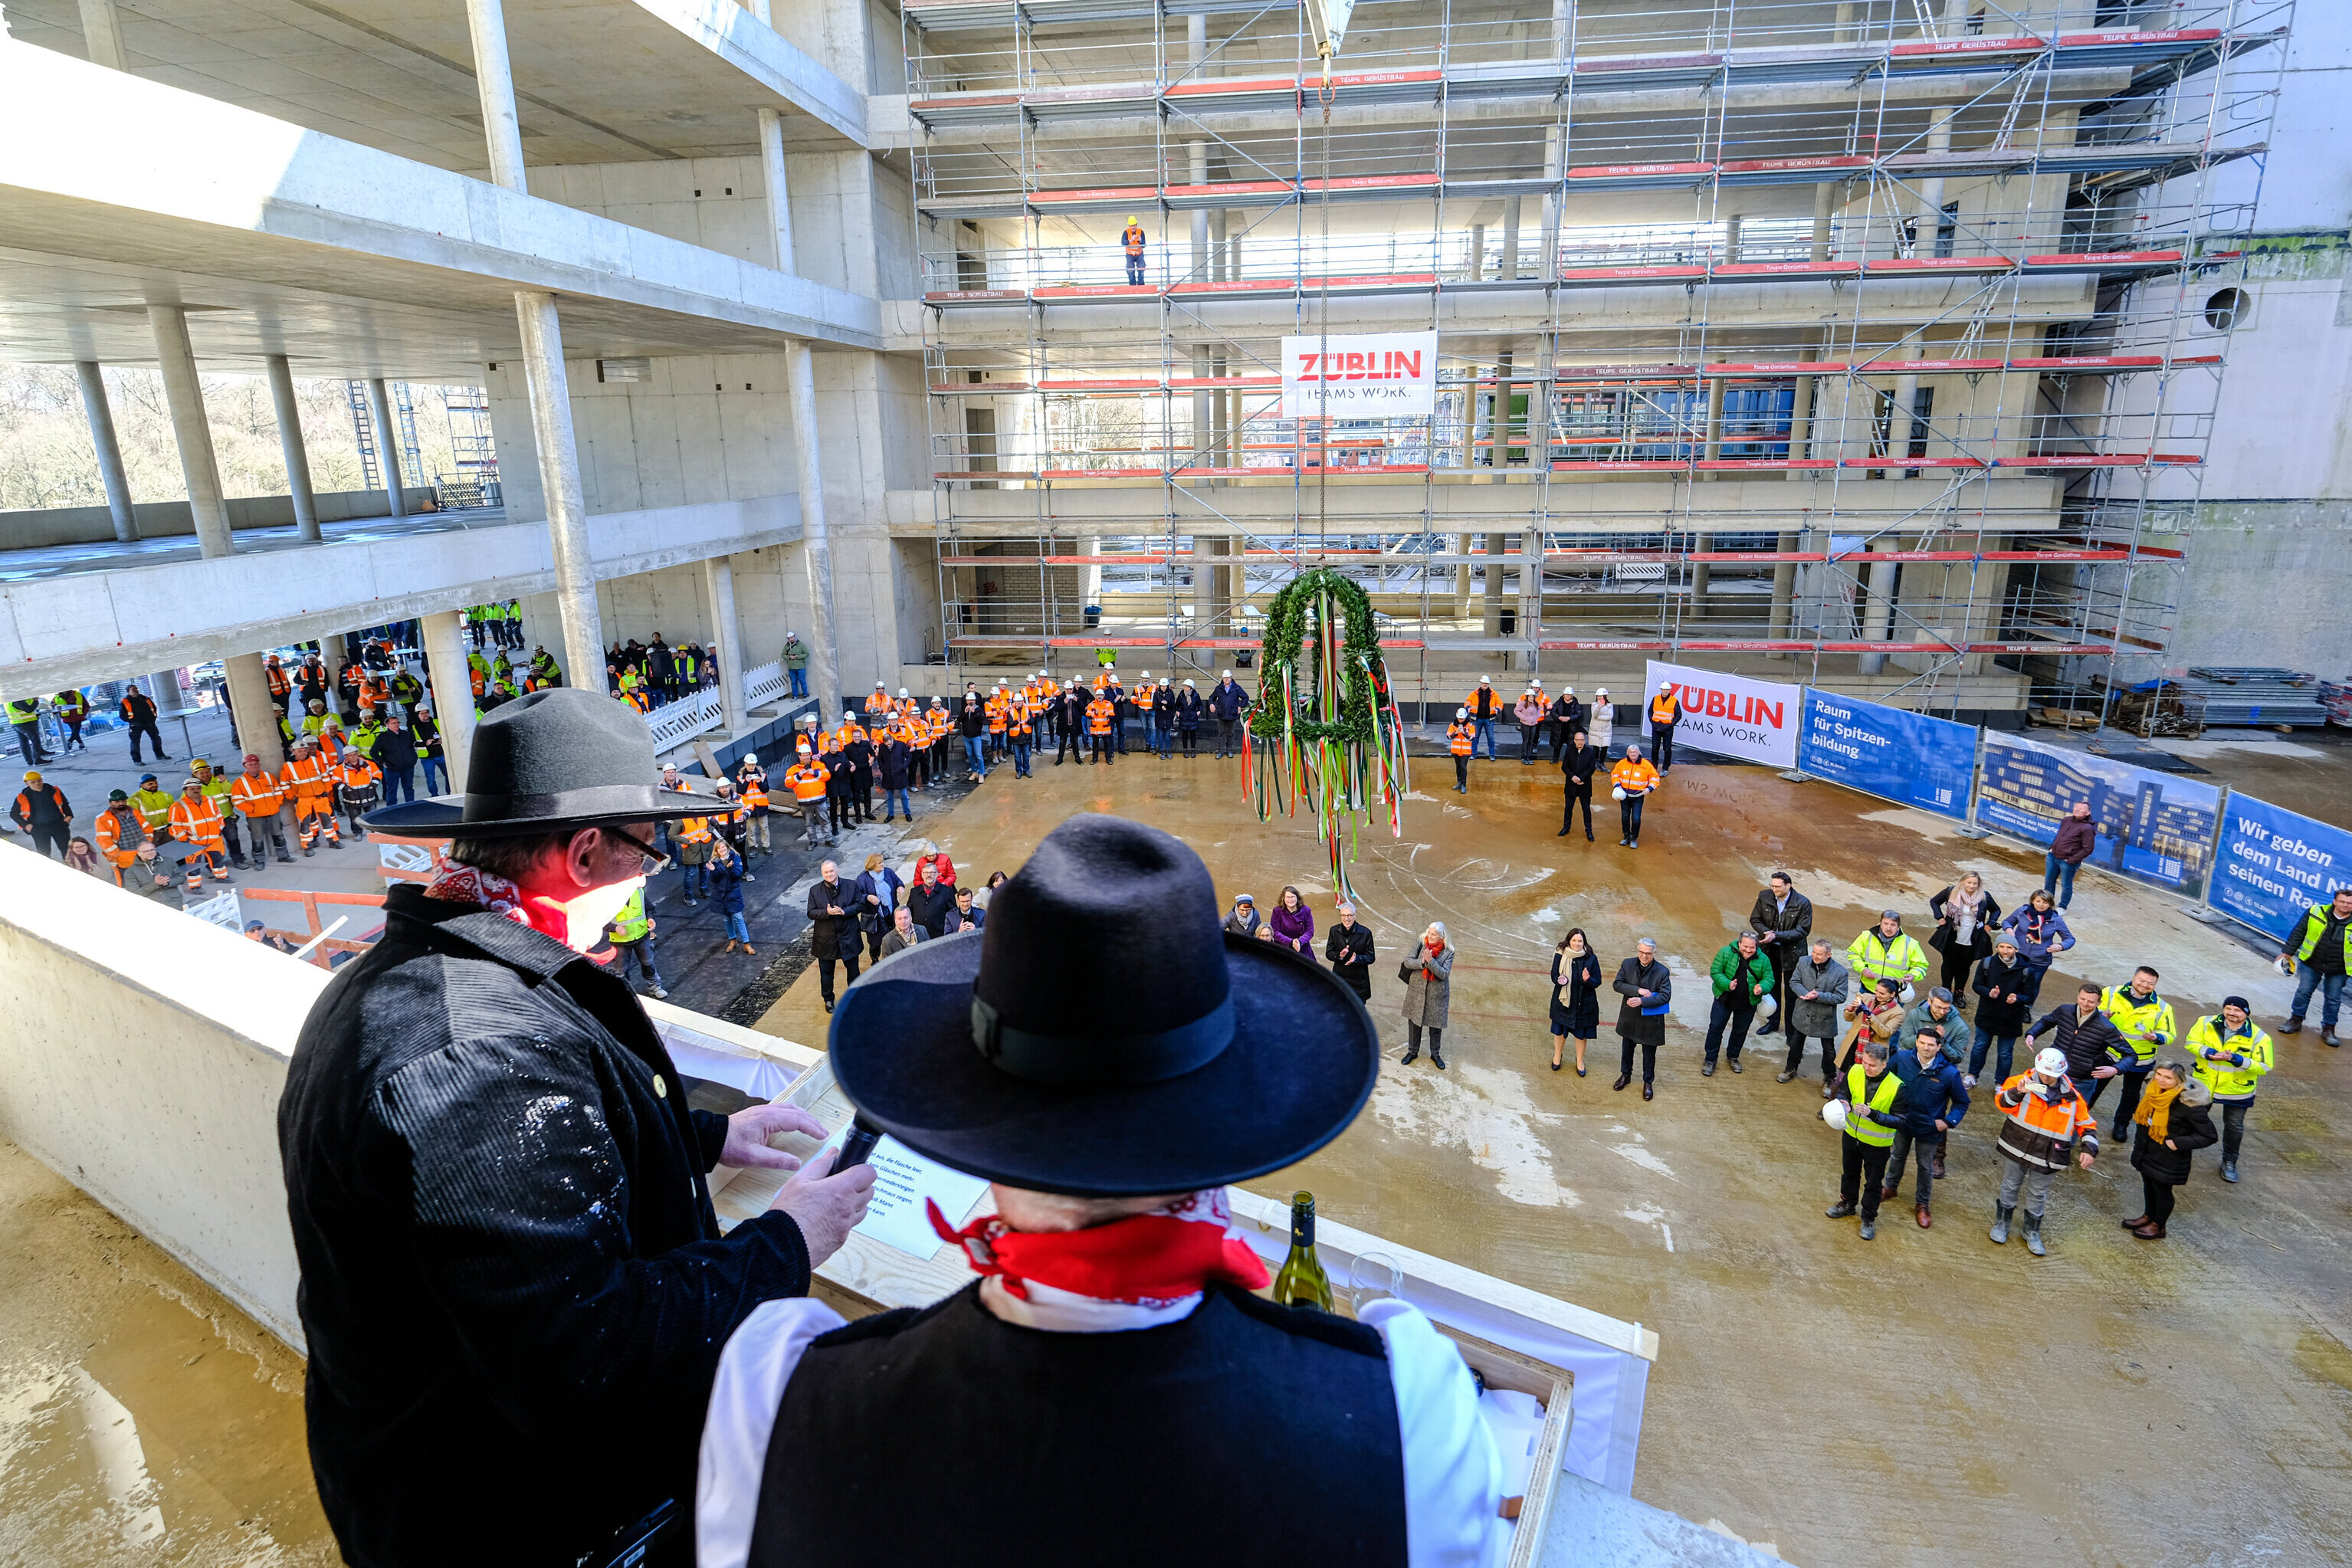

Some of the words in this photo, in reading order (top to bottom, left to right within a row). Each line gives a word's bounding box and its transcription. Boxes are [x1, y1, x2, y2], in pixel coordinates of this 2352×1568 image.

[1297, 350, 1422, 382] ZÜBLIN
[1816, 700, 1851, 720] Raum
[1721, 725, 1771, 746] WORK.
[1814, 717, 1832, 733] für
[1834, 723, 1891, 747] Spitzen-
[1812, 733, 1860, 759] bildung
[2038, 822, 2058, 834] Hauptg
[2238, 817, 2268, 841] Wir
[2270, 835, 2332, 867] geben
[2232, 841, 2271, 867] dem
[2275, 856, 2321, 889] Land
[2326, 877, 2352, 894] N
[2229, 864, 2284, 897] seinen
[2289, 887, 2319, 909] Ra
[894, 1160, 912, 1169] Flasche
[877, 1176, 914, 1192] erniedersteigen
